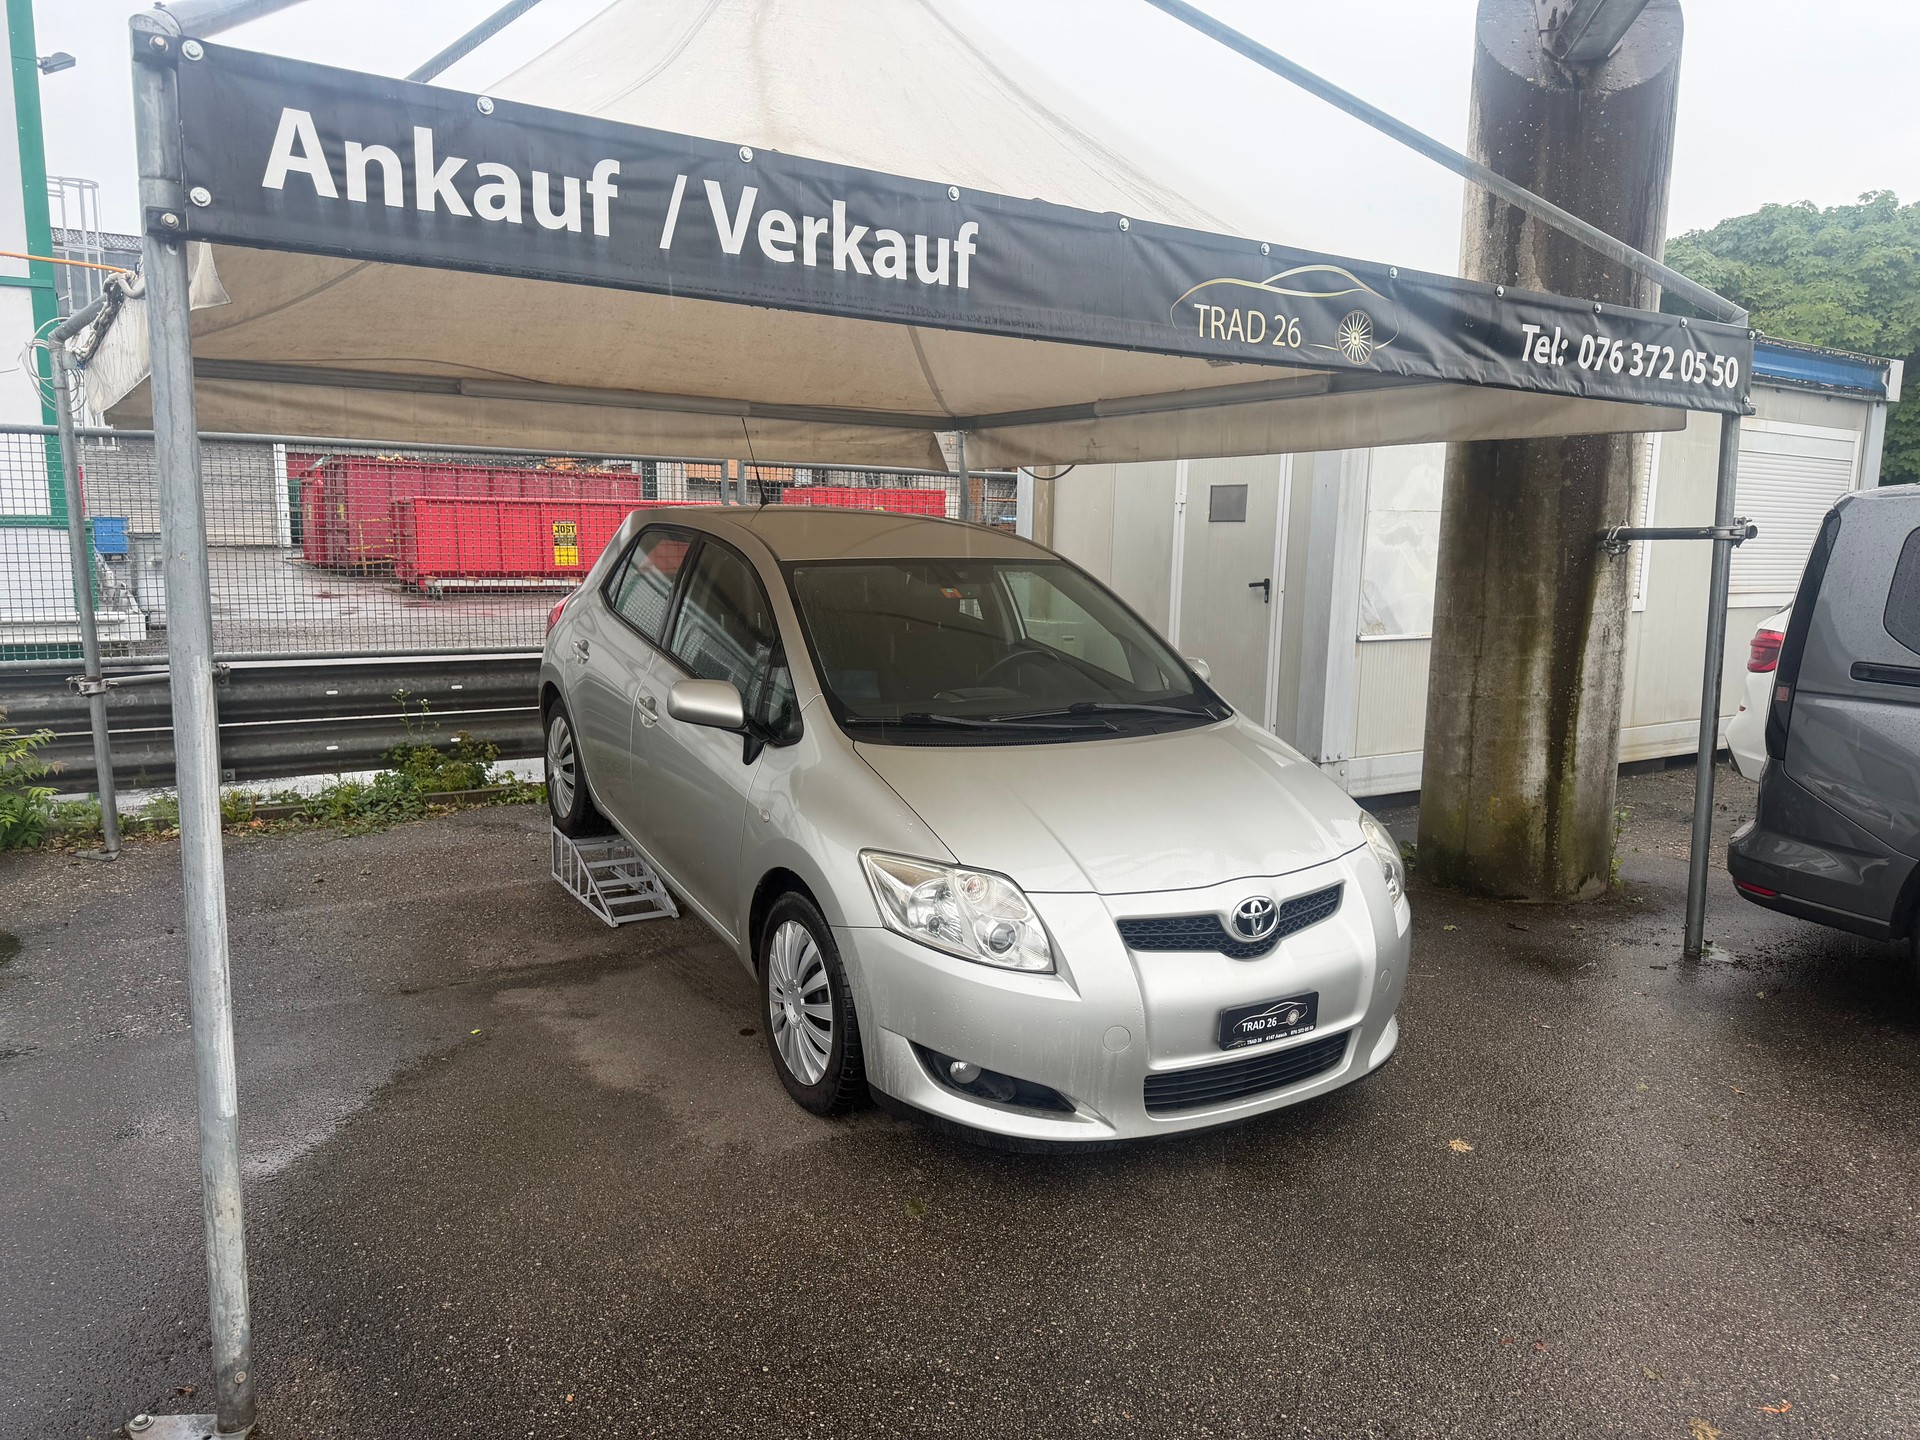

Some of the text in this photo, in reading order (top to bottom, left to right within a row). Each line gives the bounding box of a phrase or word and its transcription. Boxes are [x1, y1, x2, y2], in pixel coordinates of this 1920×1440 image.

[261, 107, 620, 237] Ankauf
[1193, 303, 1302, 348] TRAD 26
[1521, 323, 1739, 389] Tel: 076 372 05 50
[554, 524, 576, 534] JOST
[1241, 1016, 1278, 1033] TRAD 26
